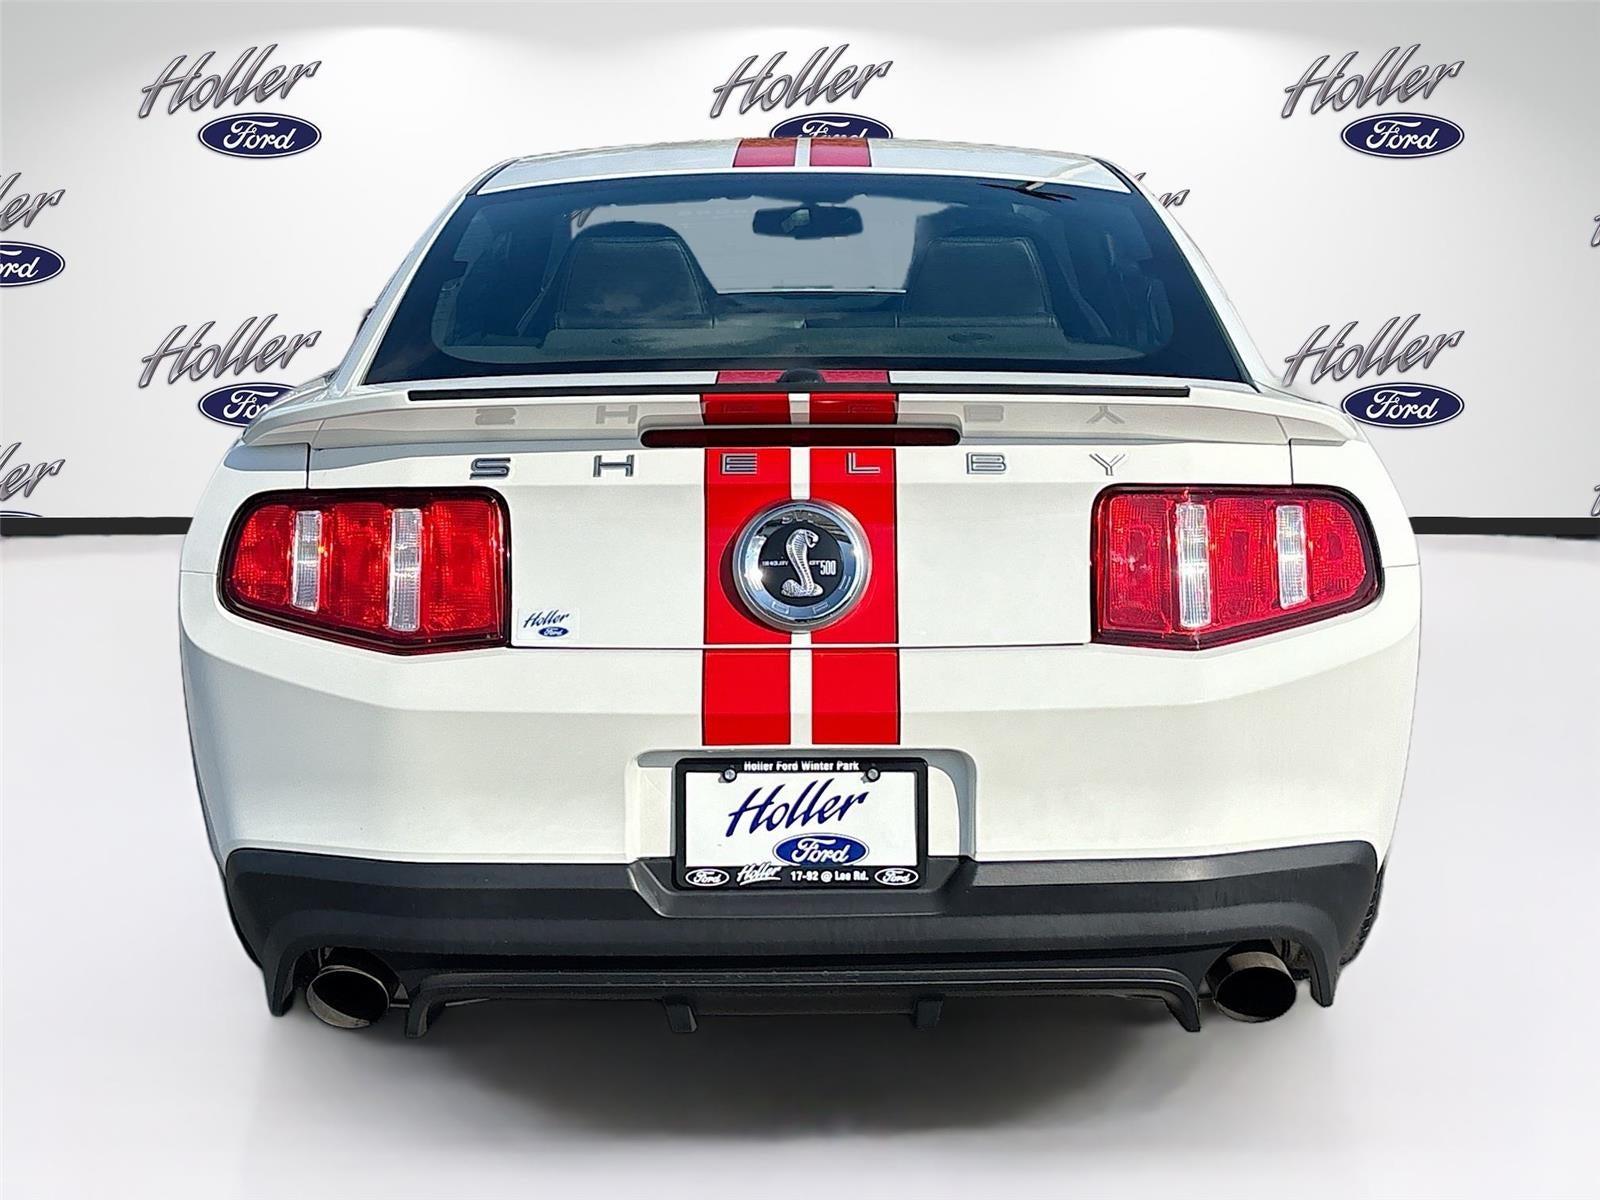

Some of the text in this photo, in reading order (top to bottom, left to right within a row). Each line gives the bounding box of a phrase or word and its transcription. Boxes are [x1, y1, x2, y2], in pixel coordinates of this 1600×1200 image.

[138, 43, 322, 119] Holler
[709, 43, 894, 119] Holler
[1281, 43, 1465, 119] Holler
[223, 119, 297, 150] Ford
[1365, 119, 1440, 150] Ford
[138, 313, 322, 389] Holler
[1281, 313, 1465, 388] Holler
[1365, 389, 1440, 420] Ford
[523, 609, 570, 628] Holler
[743, 761, 860, 771] Holler Ford Winter Park
[725, 777, 870, 838] Holler
[791, 838, 851, 863] Ford
[693, 871, 722, 884] Ford
[736, 861, 781, 883] Holler
[820, 870, 833, 883] @
[853, 870, 869, 881] Rd.
[882, 870, 911, 883] Ford
